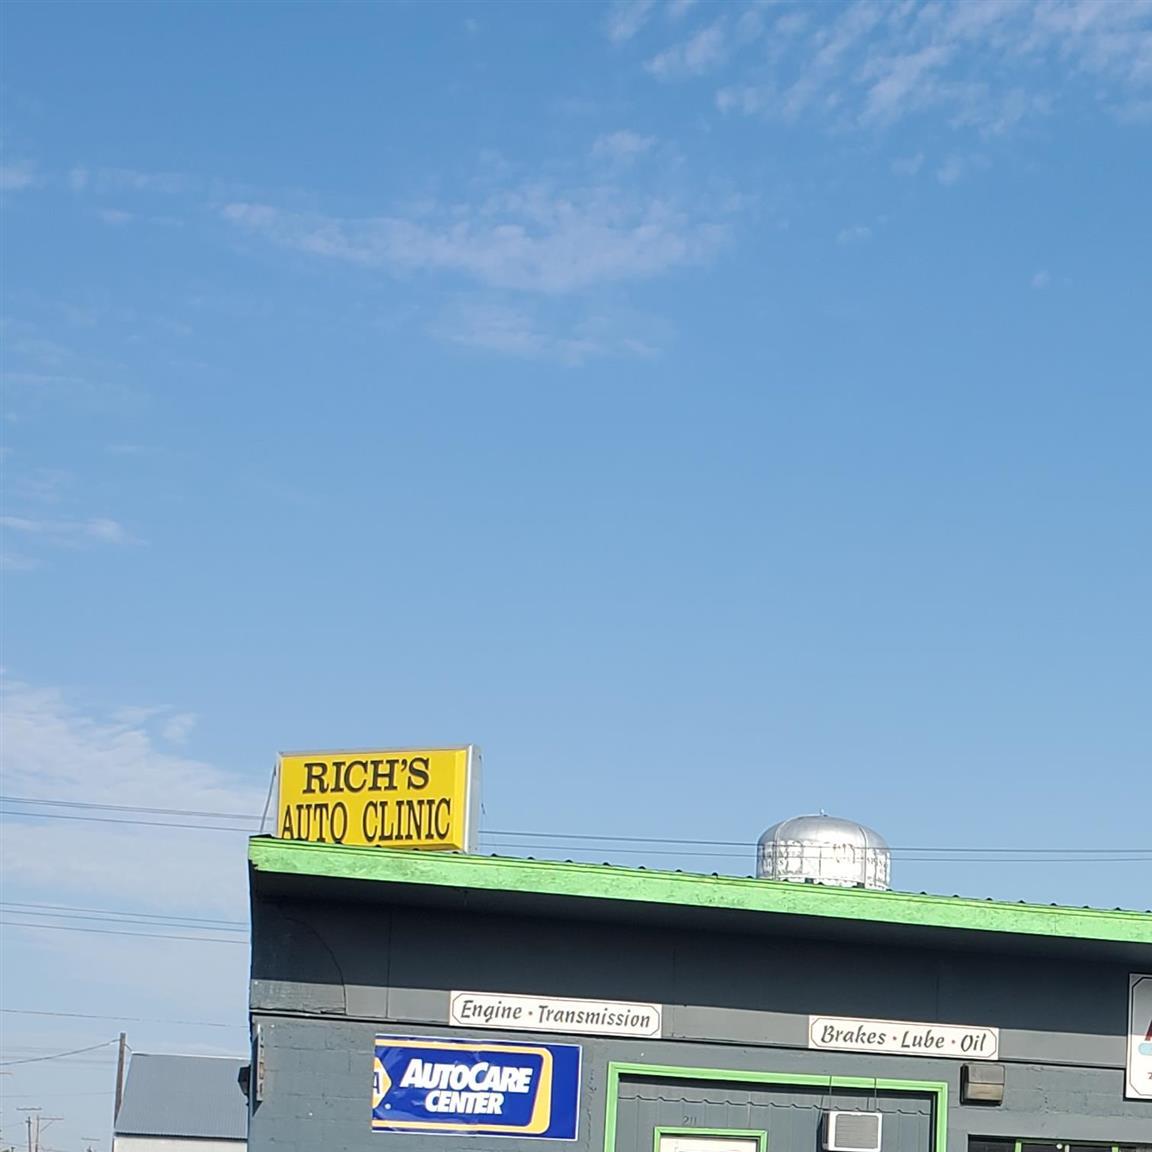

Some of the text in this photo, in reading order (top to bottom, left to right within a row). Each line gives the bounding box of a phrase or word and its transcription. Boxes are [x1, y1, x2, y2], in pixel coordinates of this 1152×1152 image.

[302, 757, 430, 794] RICH'S
[281, 797, 452, 843] AUTO CLINIC
[460, 1000, 651, 1028] Engine Transmission
[820, 1024, 987, 1052] Brakes Lube Oil
[424, 1091, 504, 1114] CENTER
